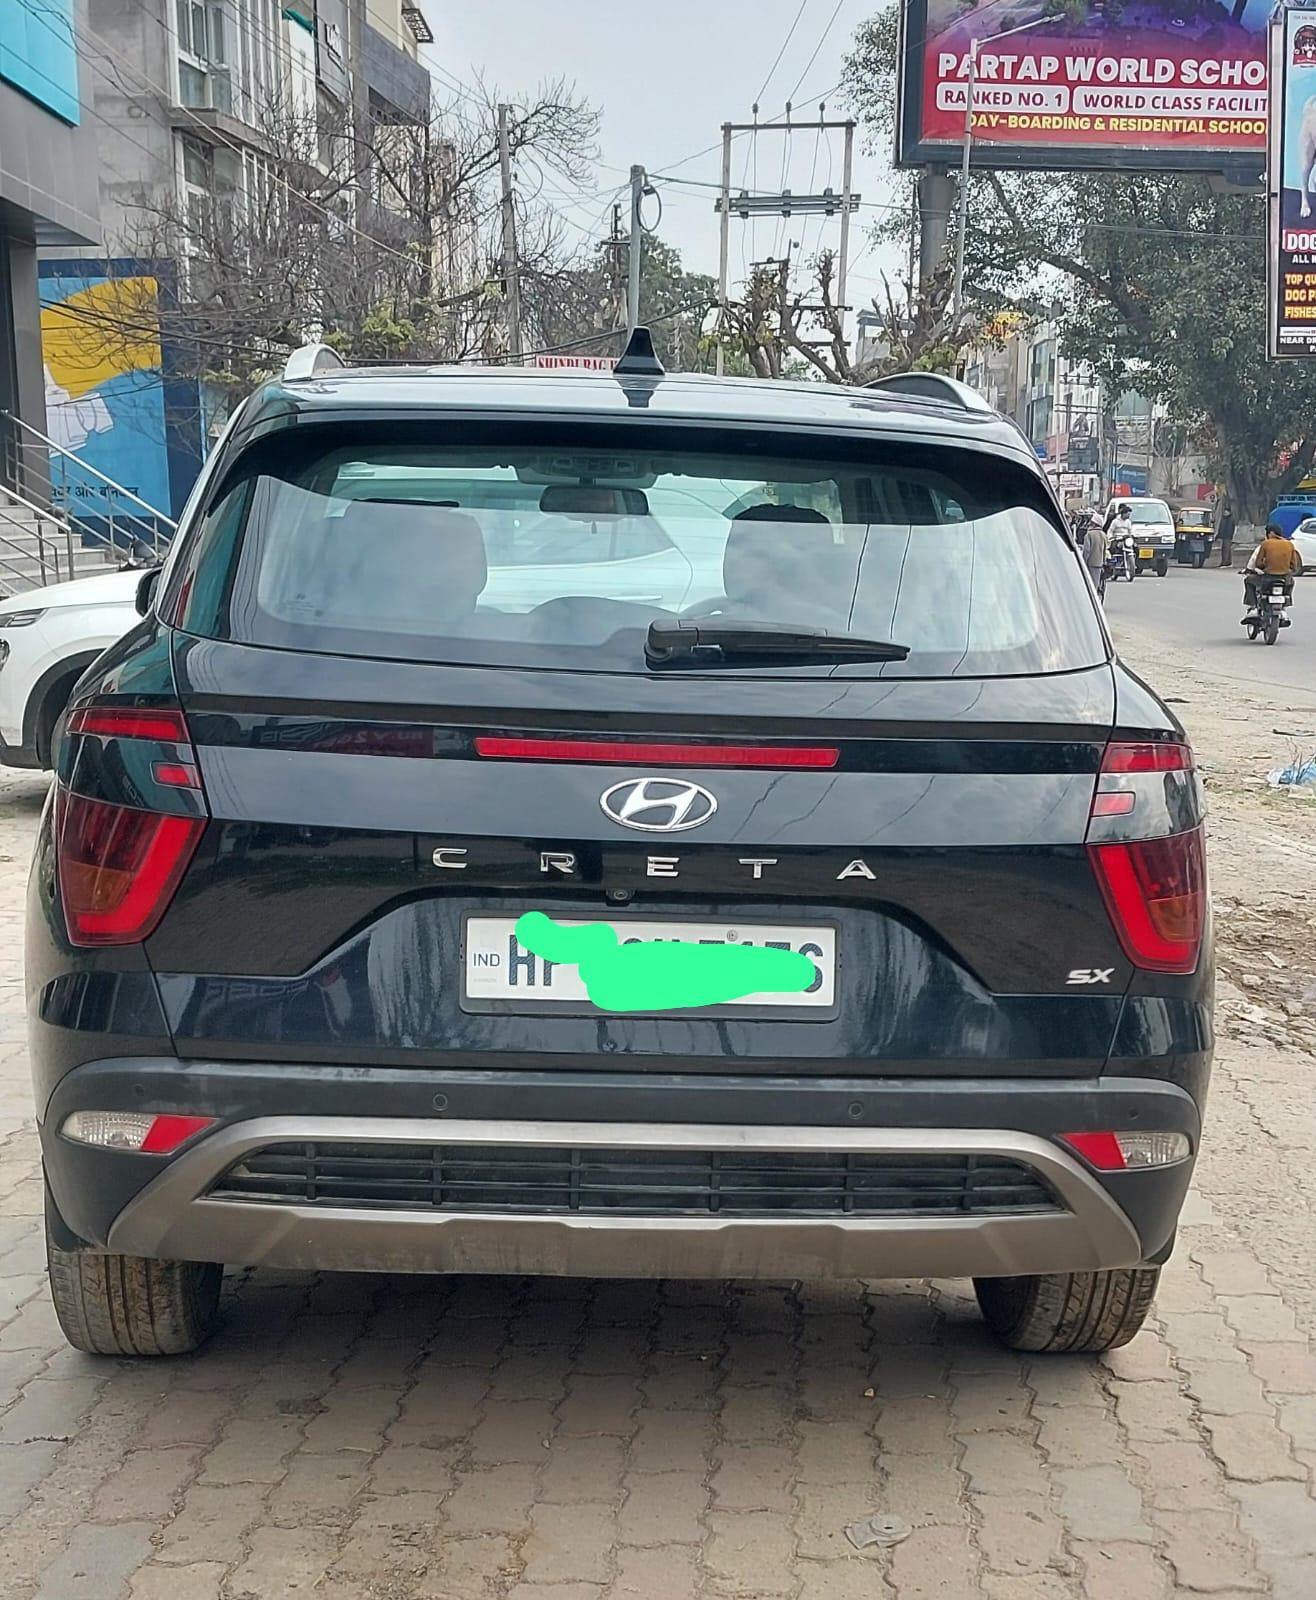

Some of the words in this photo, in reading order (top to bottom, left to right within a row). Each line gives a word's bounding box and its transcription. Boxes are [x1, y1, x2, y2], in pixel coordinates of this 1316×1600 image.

[938, 53, 1059, 80] PARTAP
[1065, 56, 1175, 83] WORLD
[1180, 59, 1267, 85] SCHO
[944, 90, 1012, 105] RANKED
[1018, 92, 1049, 107] NO.
[1054, 93, 1062, 107] 1
[1084, 94, 1146, 108] WORLD
[1151, 95, 1202, 110] CLASS
[1093, 117, 1106, 131] &
[1109, 118, 1206, 133] RESIDENTIAL
[1208, 120, 1267, 135] SCHOO
[1292, 254, 1310, 264] ALL
[1285, 273, 1303, 285] TOP
[1285, 289, 1306, 301] DOG
[1308, 289, 1316, 301] P
[1285, 306, 1316, 319] FISHES
[432, 847, 878, 880] CRETA
[473, 953, 501, 967] IND
[1065, 968, 1116, 985] SX
